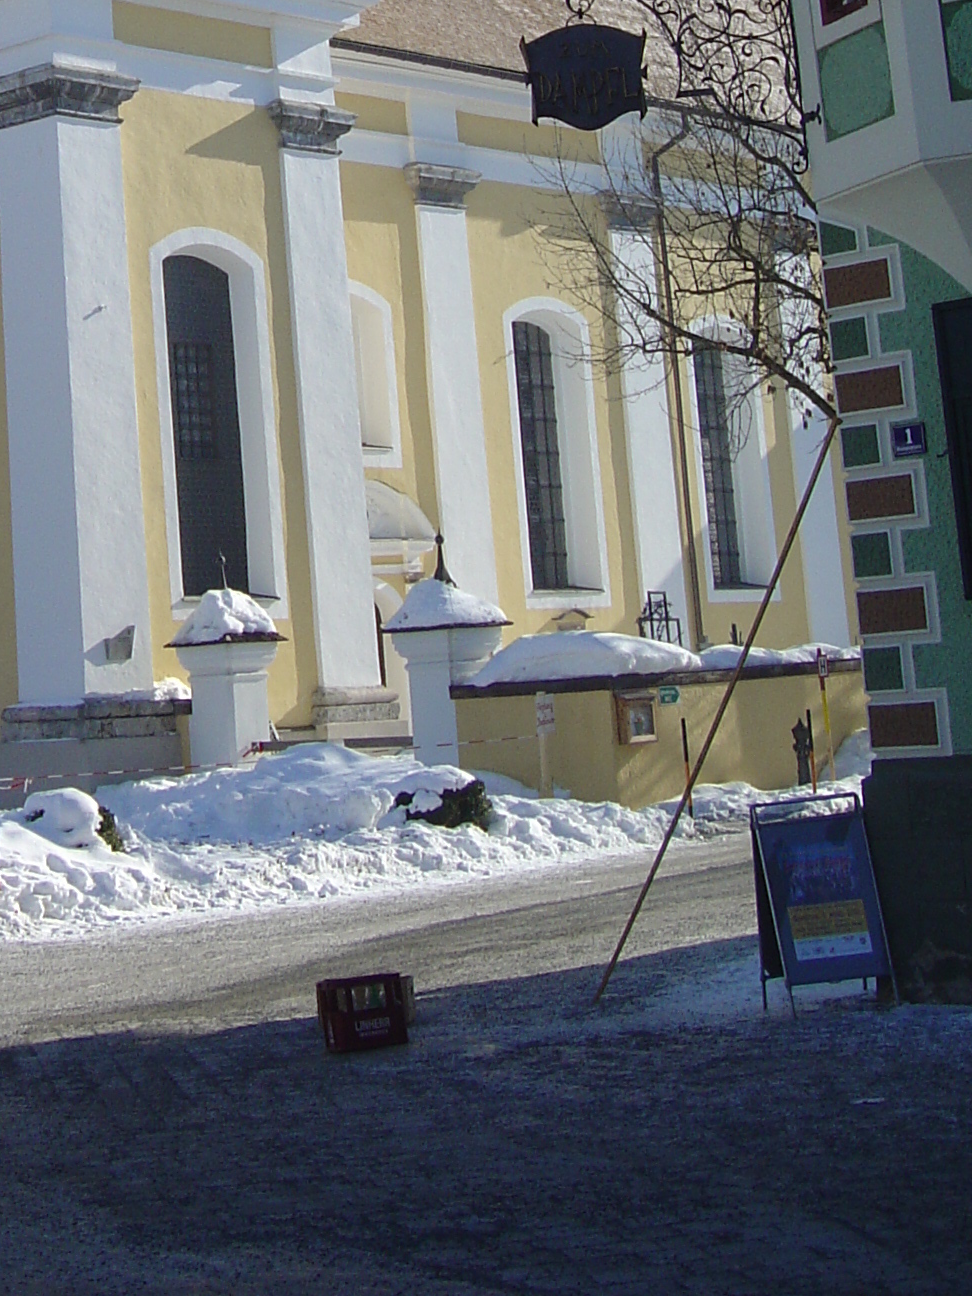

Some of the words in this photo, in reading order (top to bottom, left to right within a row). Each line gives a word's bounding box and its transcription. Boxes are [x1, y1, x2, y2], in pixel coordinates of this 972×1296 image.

[560, 41, 610, 58] ZUM
[539, 67, 640, 114] DAMPFL
[905, 428, 913, 444] 1
